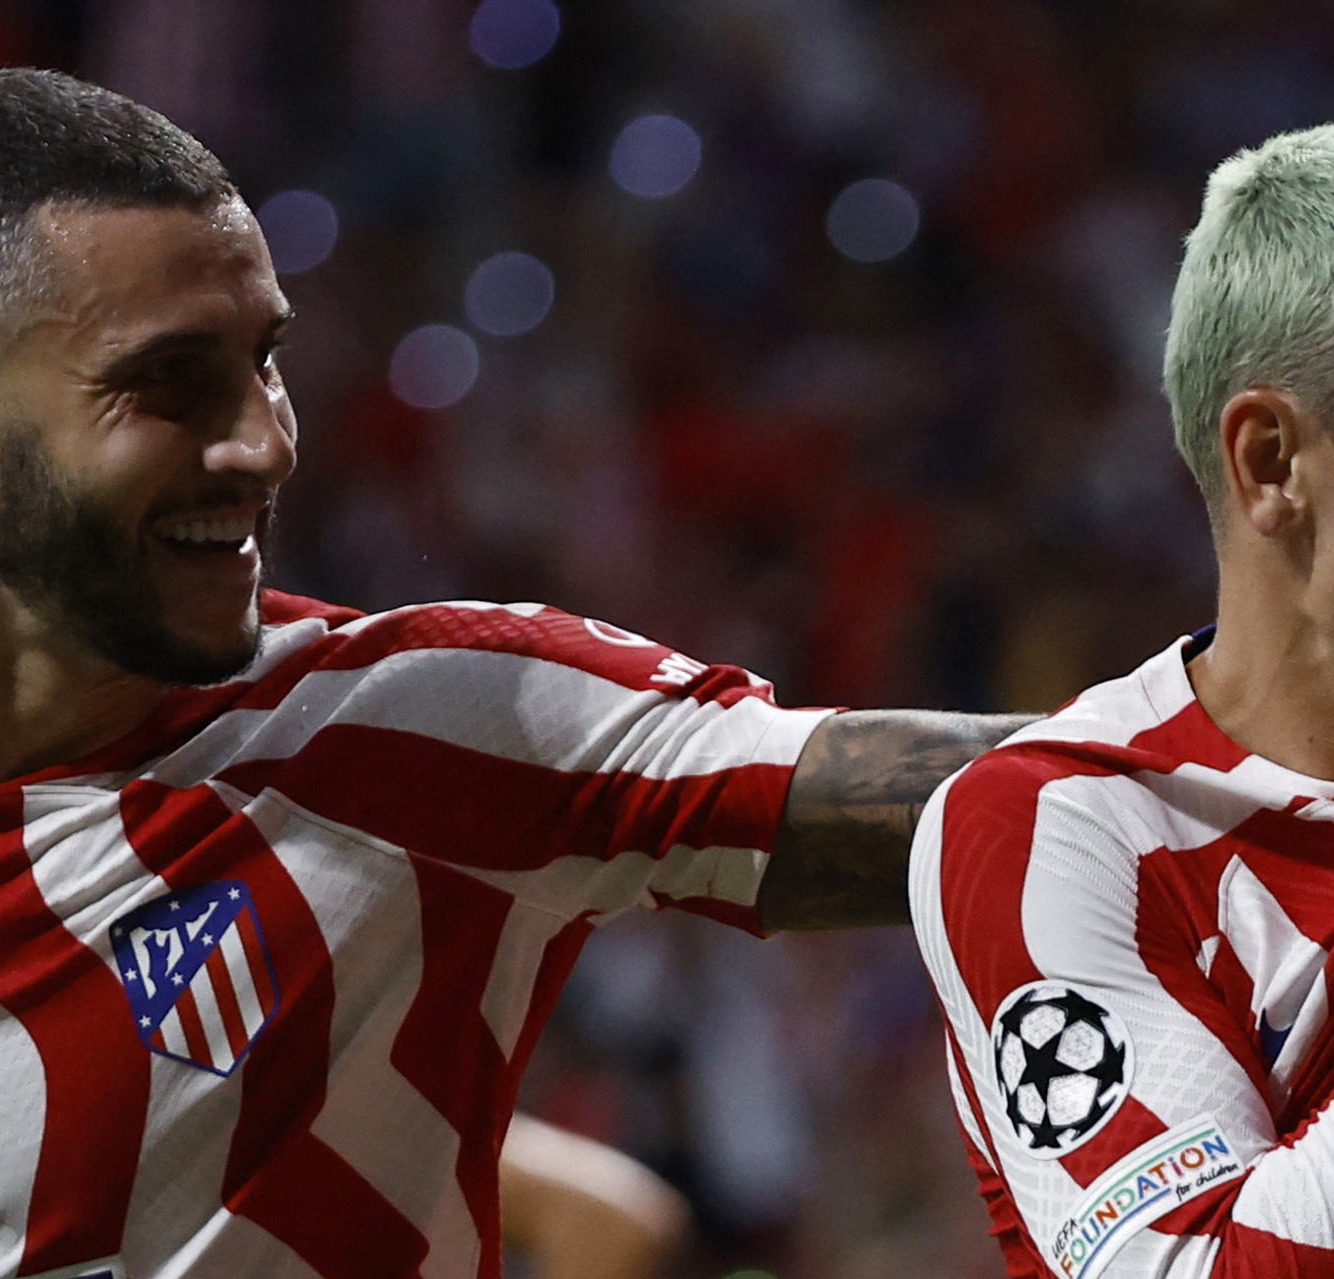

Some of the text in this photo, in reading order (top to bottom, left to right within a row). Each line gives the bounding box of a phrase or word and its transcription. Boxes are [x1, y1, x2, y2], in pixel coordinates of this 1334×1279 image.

[1175, 1162, 1239, 1202] for children
[1051, 1217, 1078, 1260] UEFA
